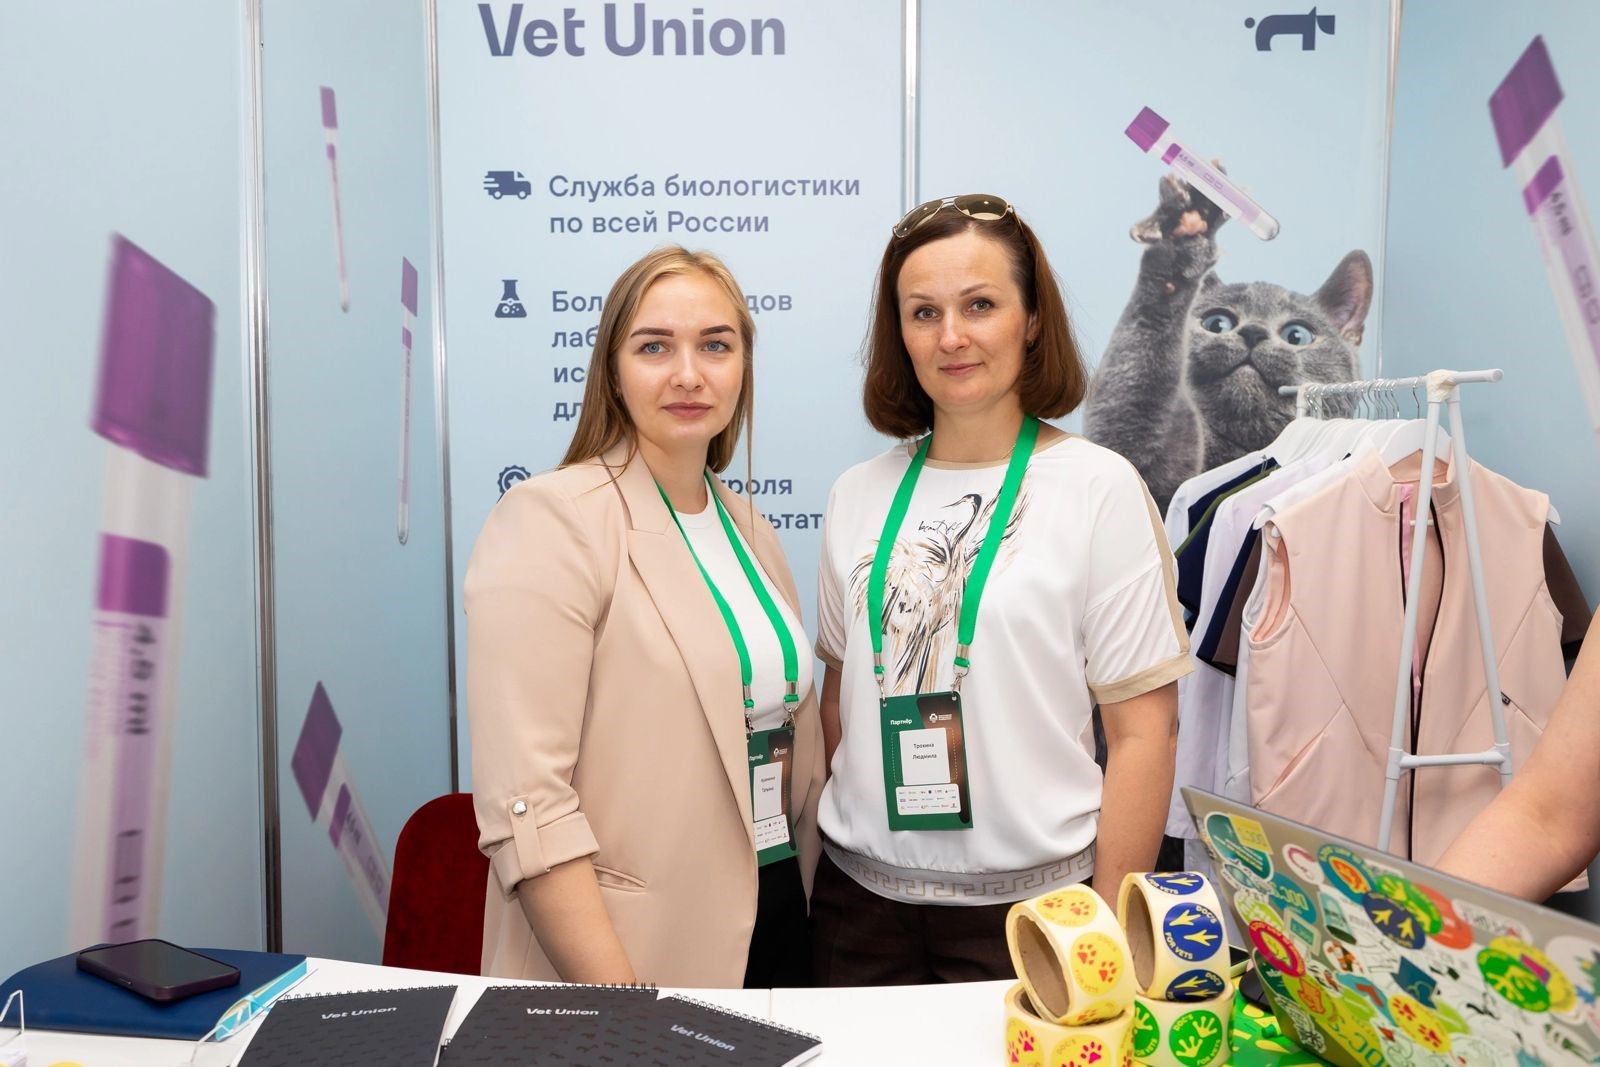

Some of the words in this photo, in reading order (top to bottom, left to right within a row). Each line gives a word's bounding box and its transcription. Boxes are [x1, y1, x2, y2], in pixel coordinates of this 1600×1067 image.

[478, 4, 585, 56] Vet
[603, 4, 786, 56] Union
[549, 174, 655, 202] Служба
[664, 175, 860, 196] биологистики
[550, 216, 583, 234] по
[592, 211, 658, 234] всей
[667, 212, 769, 233] России
[552, 290, 603, 312] Бол
[746, 295, 792, 315] дов
[553, 402, 582, 421] дл
[721, 479, 793, 495] роля
[1174, 946, 1194, 960] VETS
[321, 1012, 349, 1020] Vet
[351, 1006, 397, 1016] Union
[526, 1007, 553, 1015] Vet
[555, 1008, 600, 1016] Union
[670, 1024, 695, 1037] Vet
[694, 1032, 736, 1052] Union
